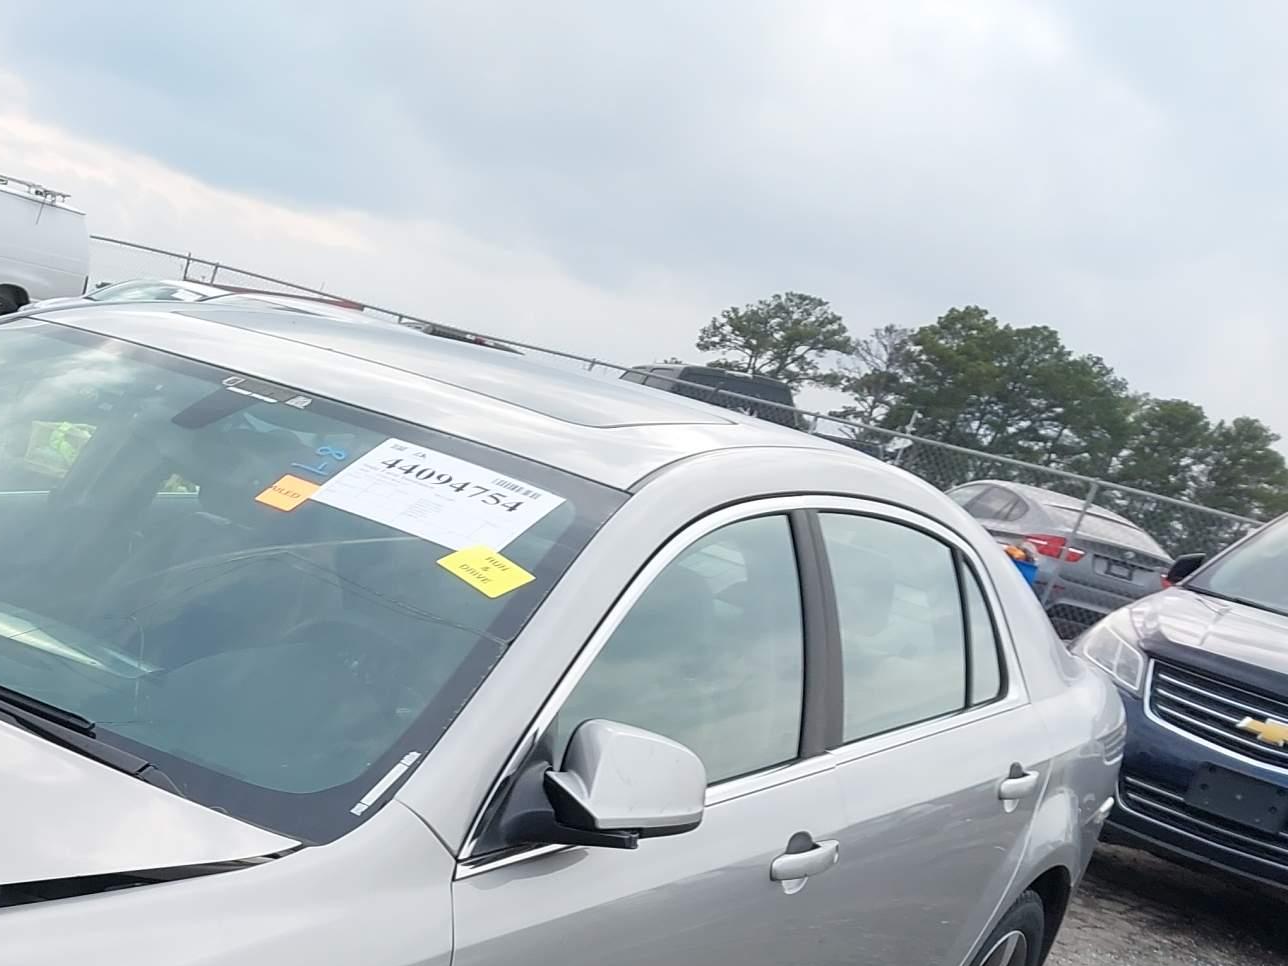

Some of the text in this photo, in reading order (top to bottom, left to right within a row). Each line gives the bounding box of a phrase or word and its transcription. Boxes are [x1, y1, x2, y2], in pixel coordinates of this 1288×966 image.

[380, 458, 524, 512] 44094754
[485, 556, 511, 571] RUN
[459, 564, 493, 584] DRIVE
